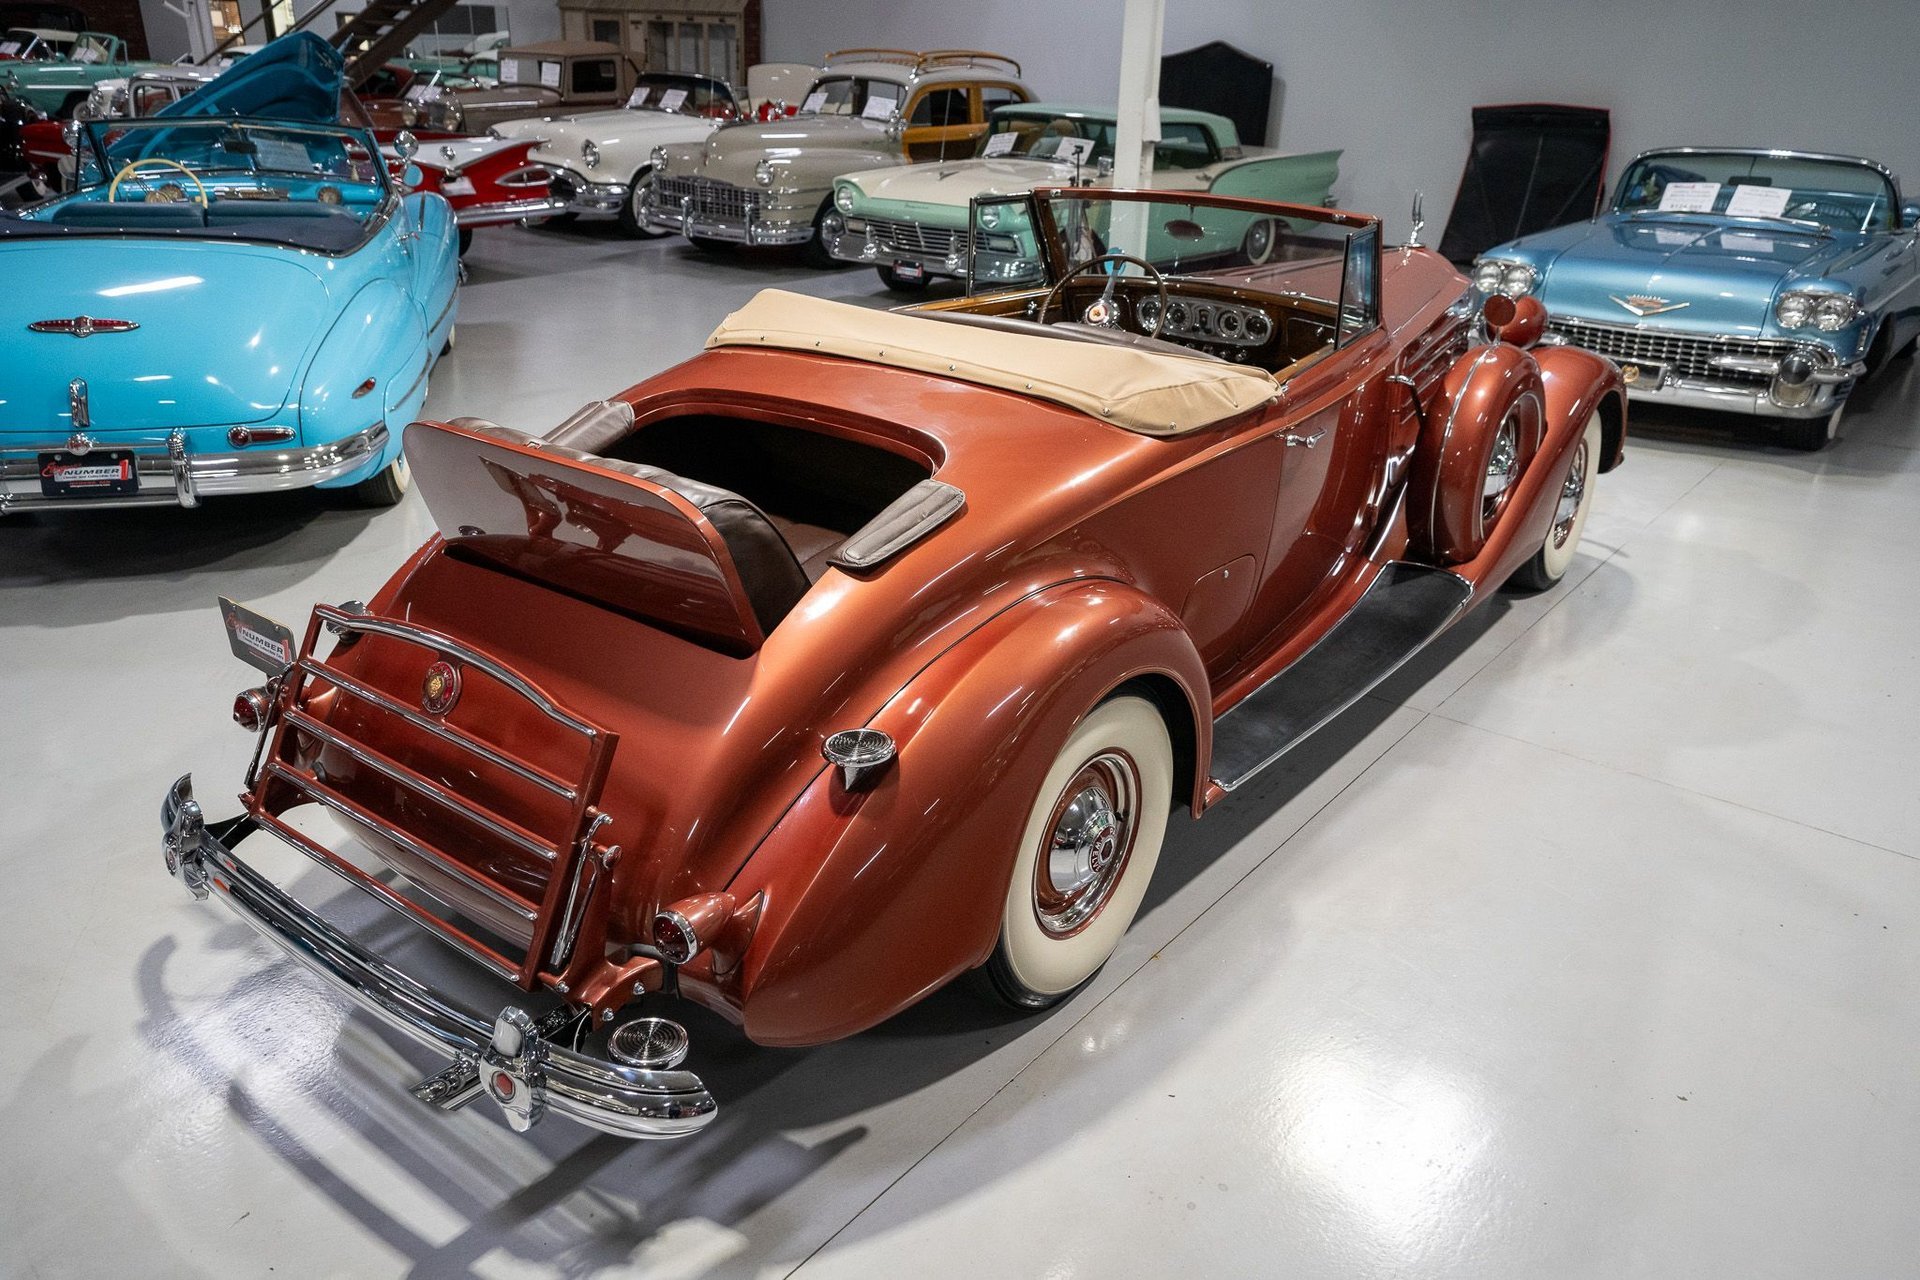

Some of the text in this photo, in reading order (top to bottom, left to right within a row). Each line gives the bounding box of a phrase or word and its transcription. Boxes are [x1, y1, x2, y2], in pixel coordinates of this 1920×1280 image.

[64, 468, 119, 476] NUMBER
[119, 459, 129, 481] 1
[242, 629, 284, 654] NUMBER
